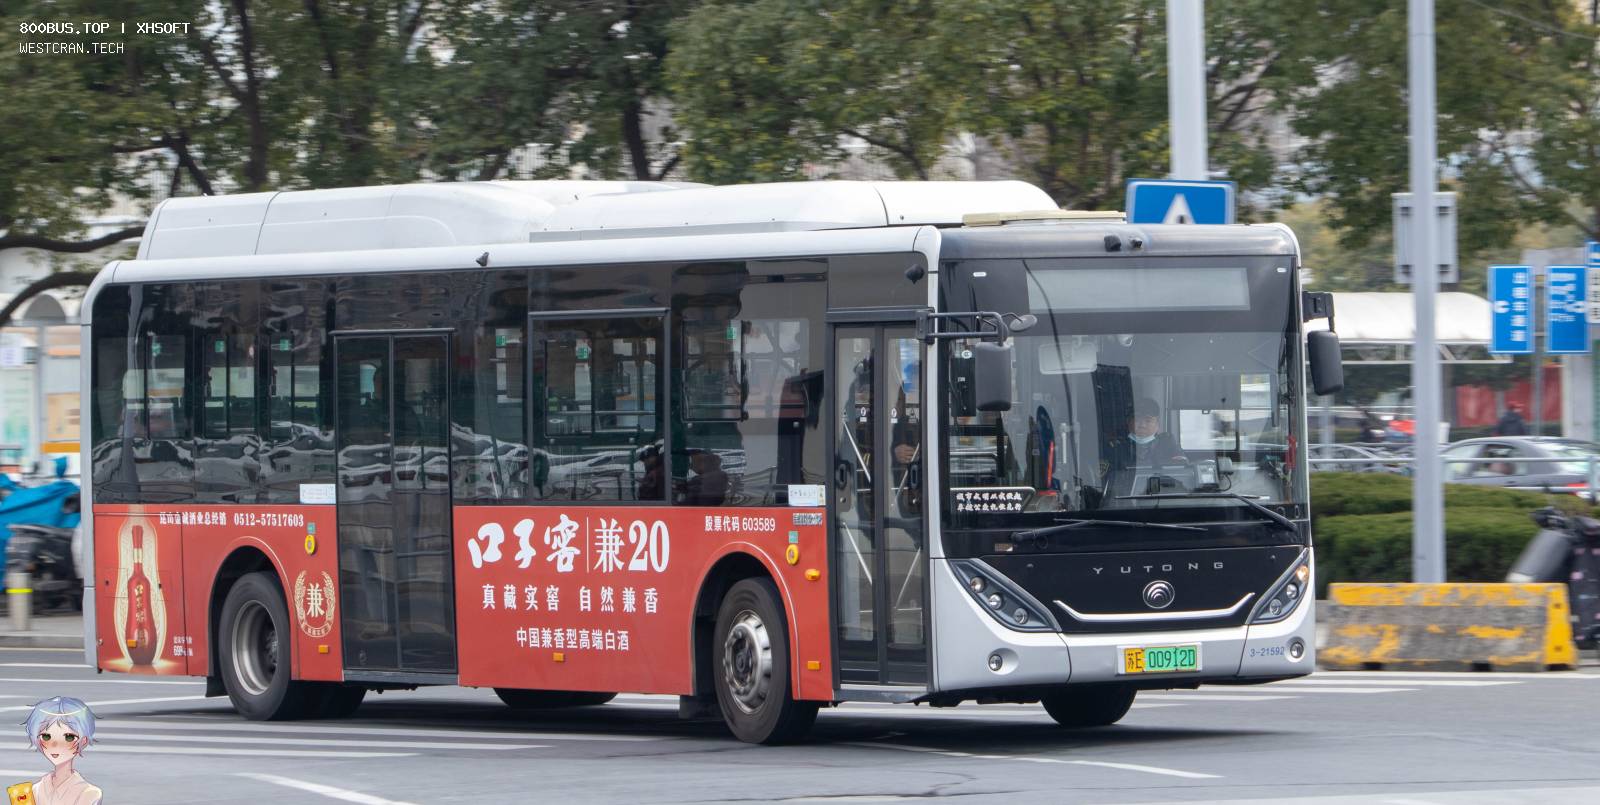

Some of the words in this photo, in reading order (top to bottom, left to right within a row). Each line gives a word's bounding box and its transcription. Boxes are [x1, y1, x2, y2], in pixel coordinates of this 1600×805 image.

[234, 513, 304, 527] 0512-57517603
[705, 515, 740, 532] 股票代码
[742, 517, 776, 532] 603589
[467, 514, 580, 573] 口子窖
[1092, 561, 1224, 575] YUTONG
[306, 582, 325, 617] 兼
[482, 584, 560, 612] 真藏实窖
[579, 586, 658, 614] 自然兼香
[516, 627, 630, 652] 中国兼香型高端白酒
[1148, 648, 1196, 669] 00912D
[1249, 646, 1285, 657] 3-21592
